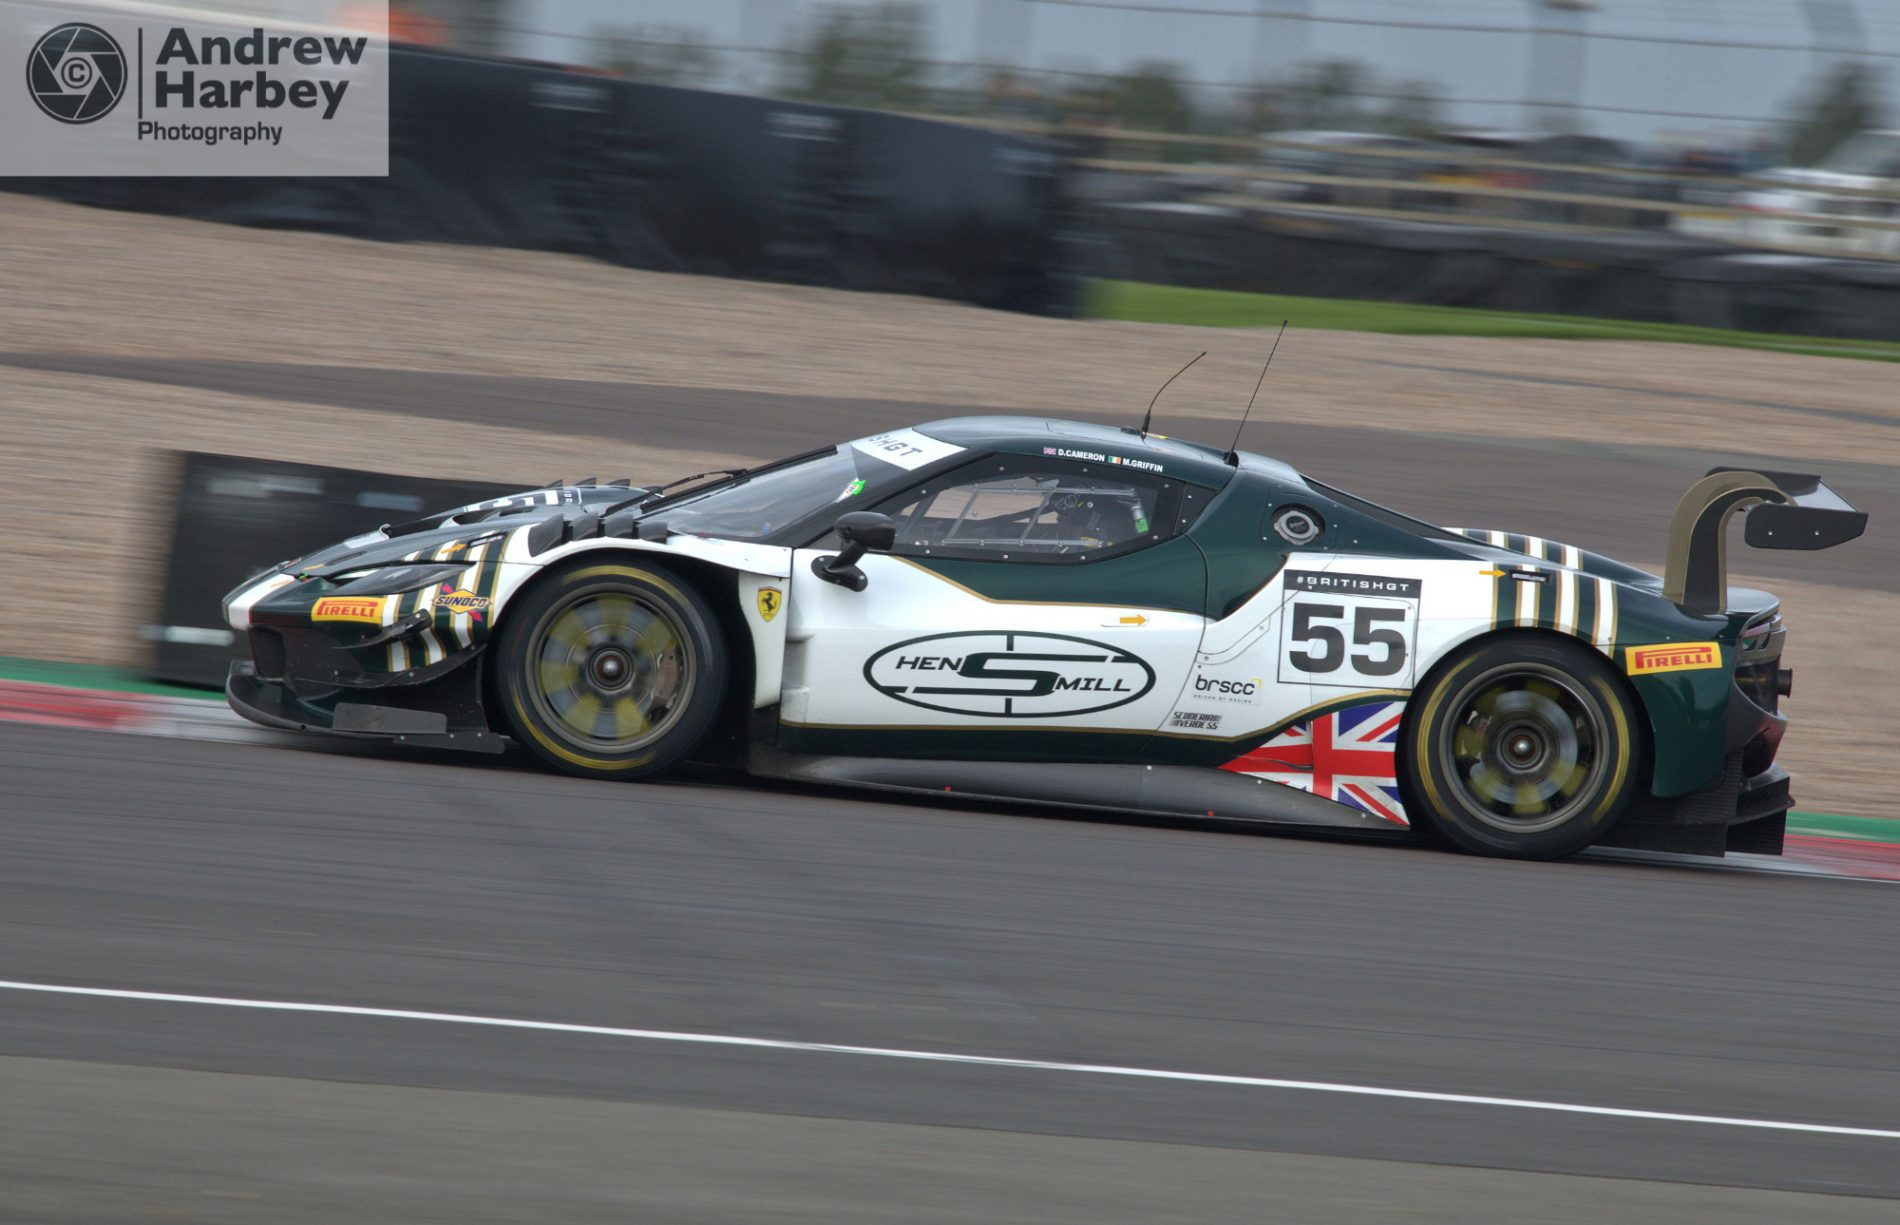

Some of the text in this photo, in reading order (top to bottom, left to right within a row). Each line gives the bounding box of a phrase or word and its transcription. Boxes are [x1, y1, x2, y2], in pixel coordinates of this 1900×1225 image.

[1057, 448, 1105, 462] D.CAMERON
[1122, 457, 1164, 473] M.GRIFFIN
[1296, 575, 1410, 592] #BRITISHGT
[316, 600, 379, 618] PIRELLI
[435, 597, 490, 608] SUNOCO
[1289, 602, 1407, 677] 55
[1634, 646, 1713, 670] PIRELLI
[1195, 674, 1255, 695] brscc
